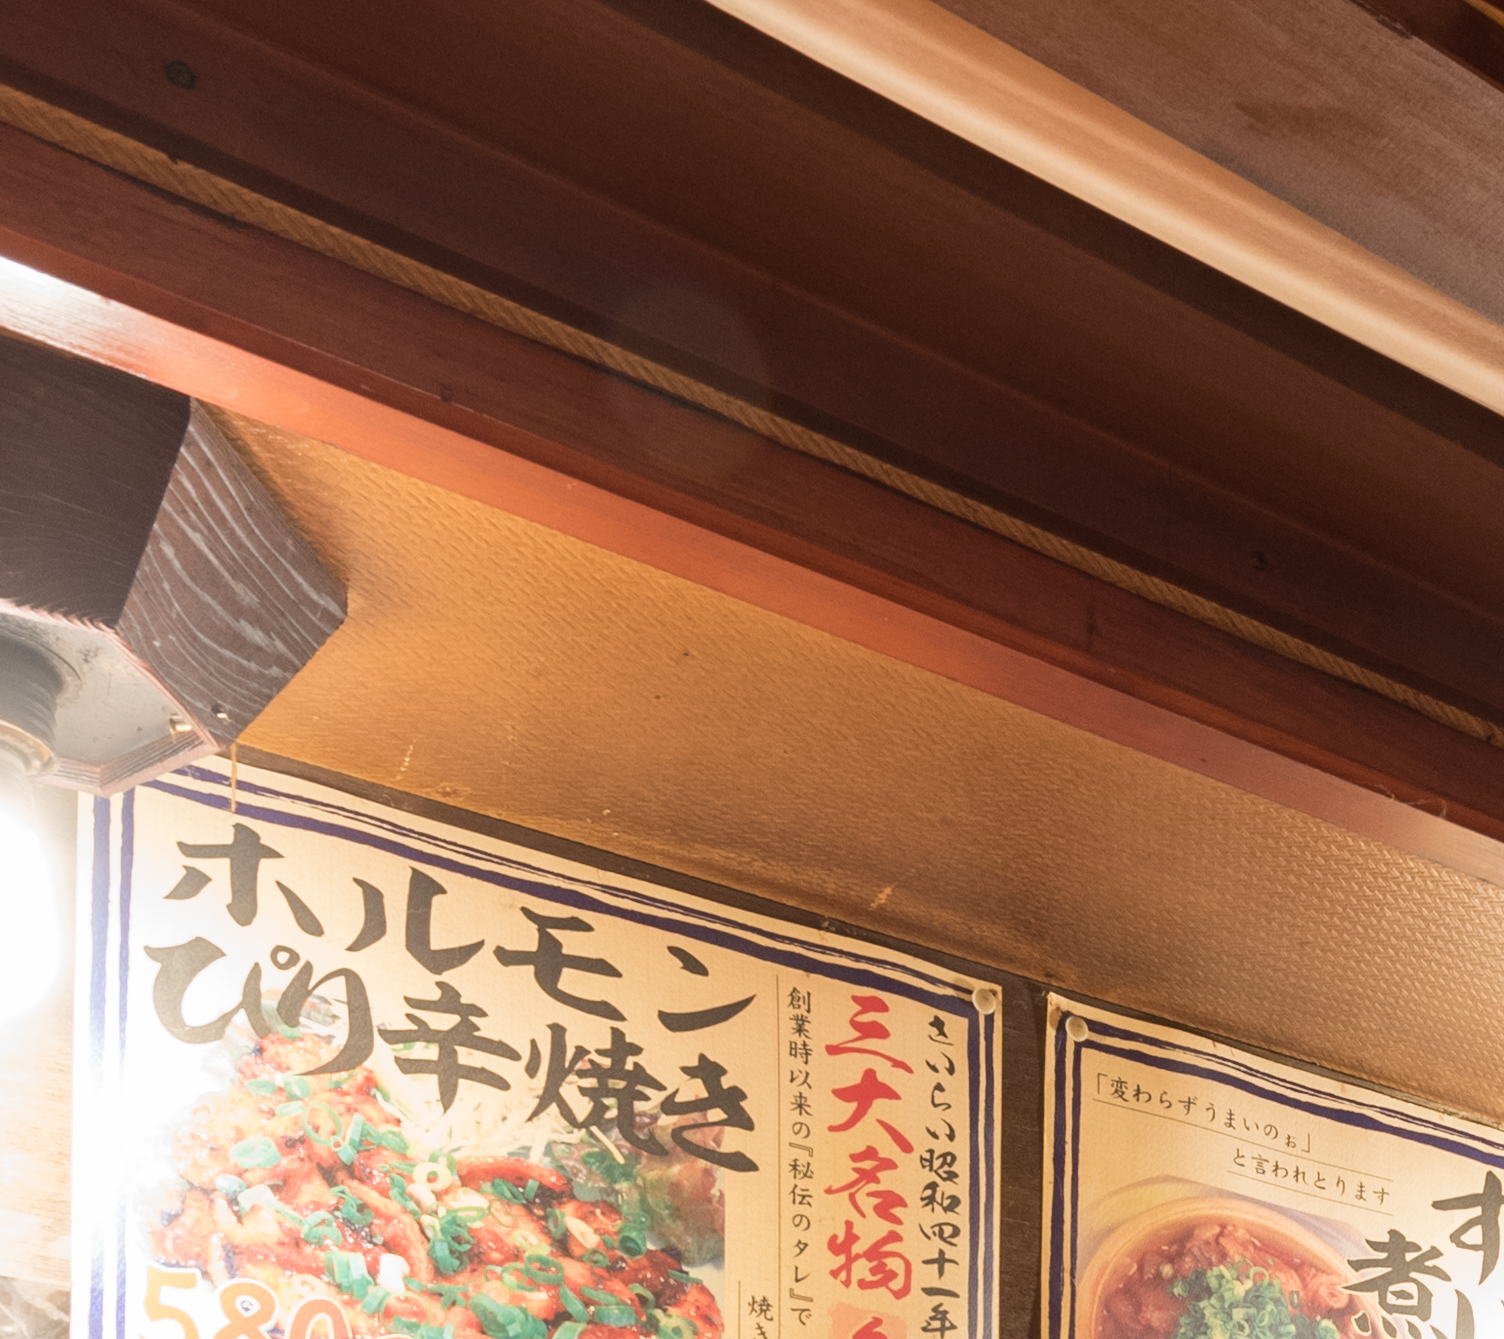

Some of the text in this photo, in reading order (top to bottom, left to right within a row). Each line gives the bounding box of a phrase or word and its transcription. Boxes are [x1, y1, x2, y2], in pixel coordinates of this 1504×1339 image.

[165, 822, 758, 1033] ホルモン
[145, 935, 759, 1171] ぴり辛焼き
[823, 994, 915, 1300] 三大名物
[1232, 1149, 1390, 1206] と言われとります
